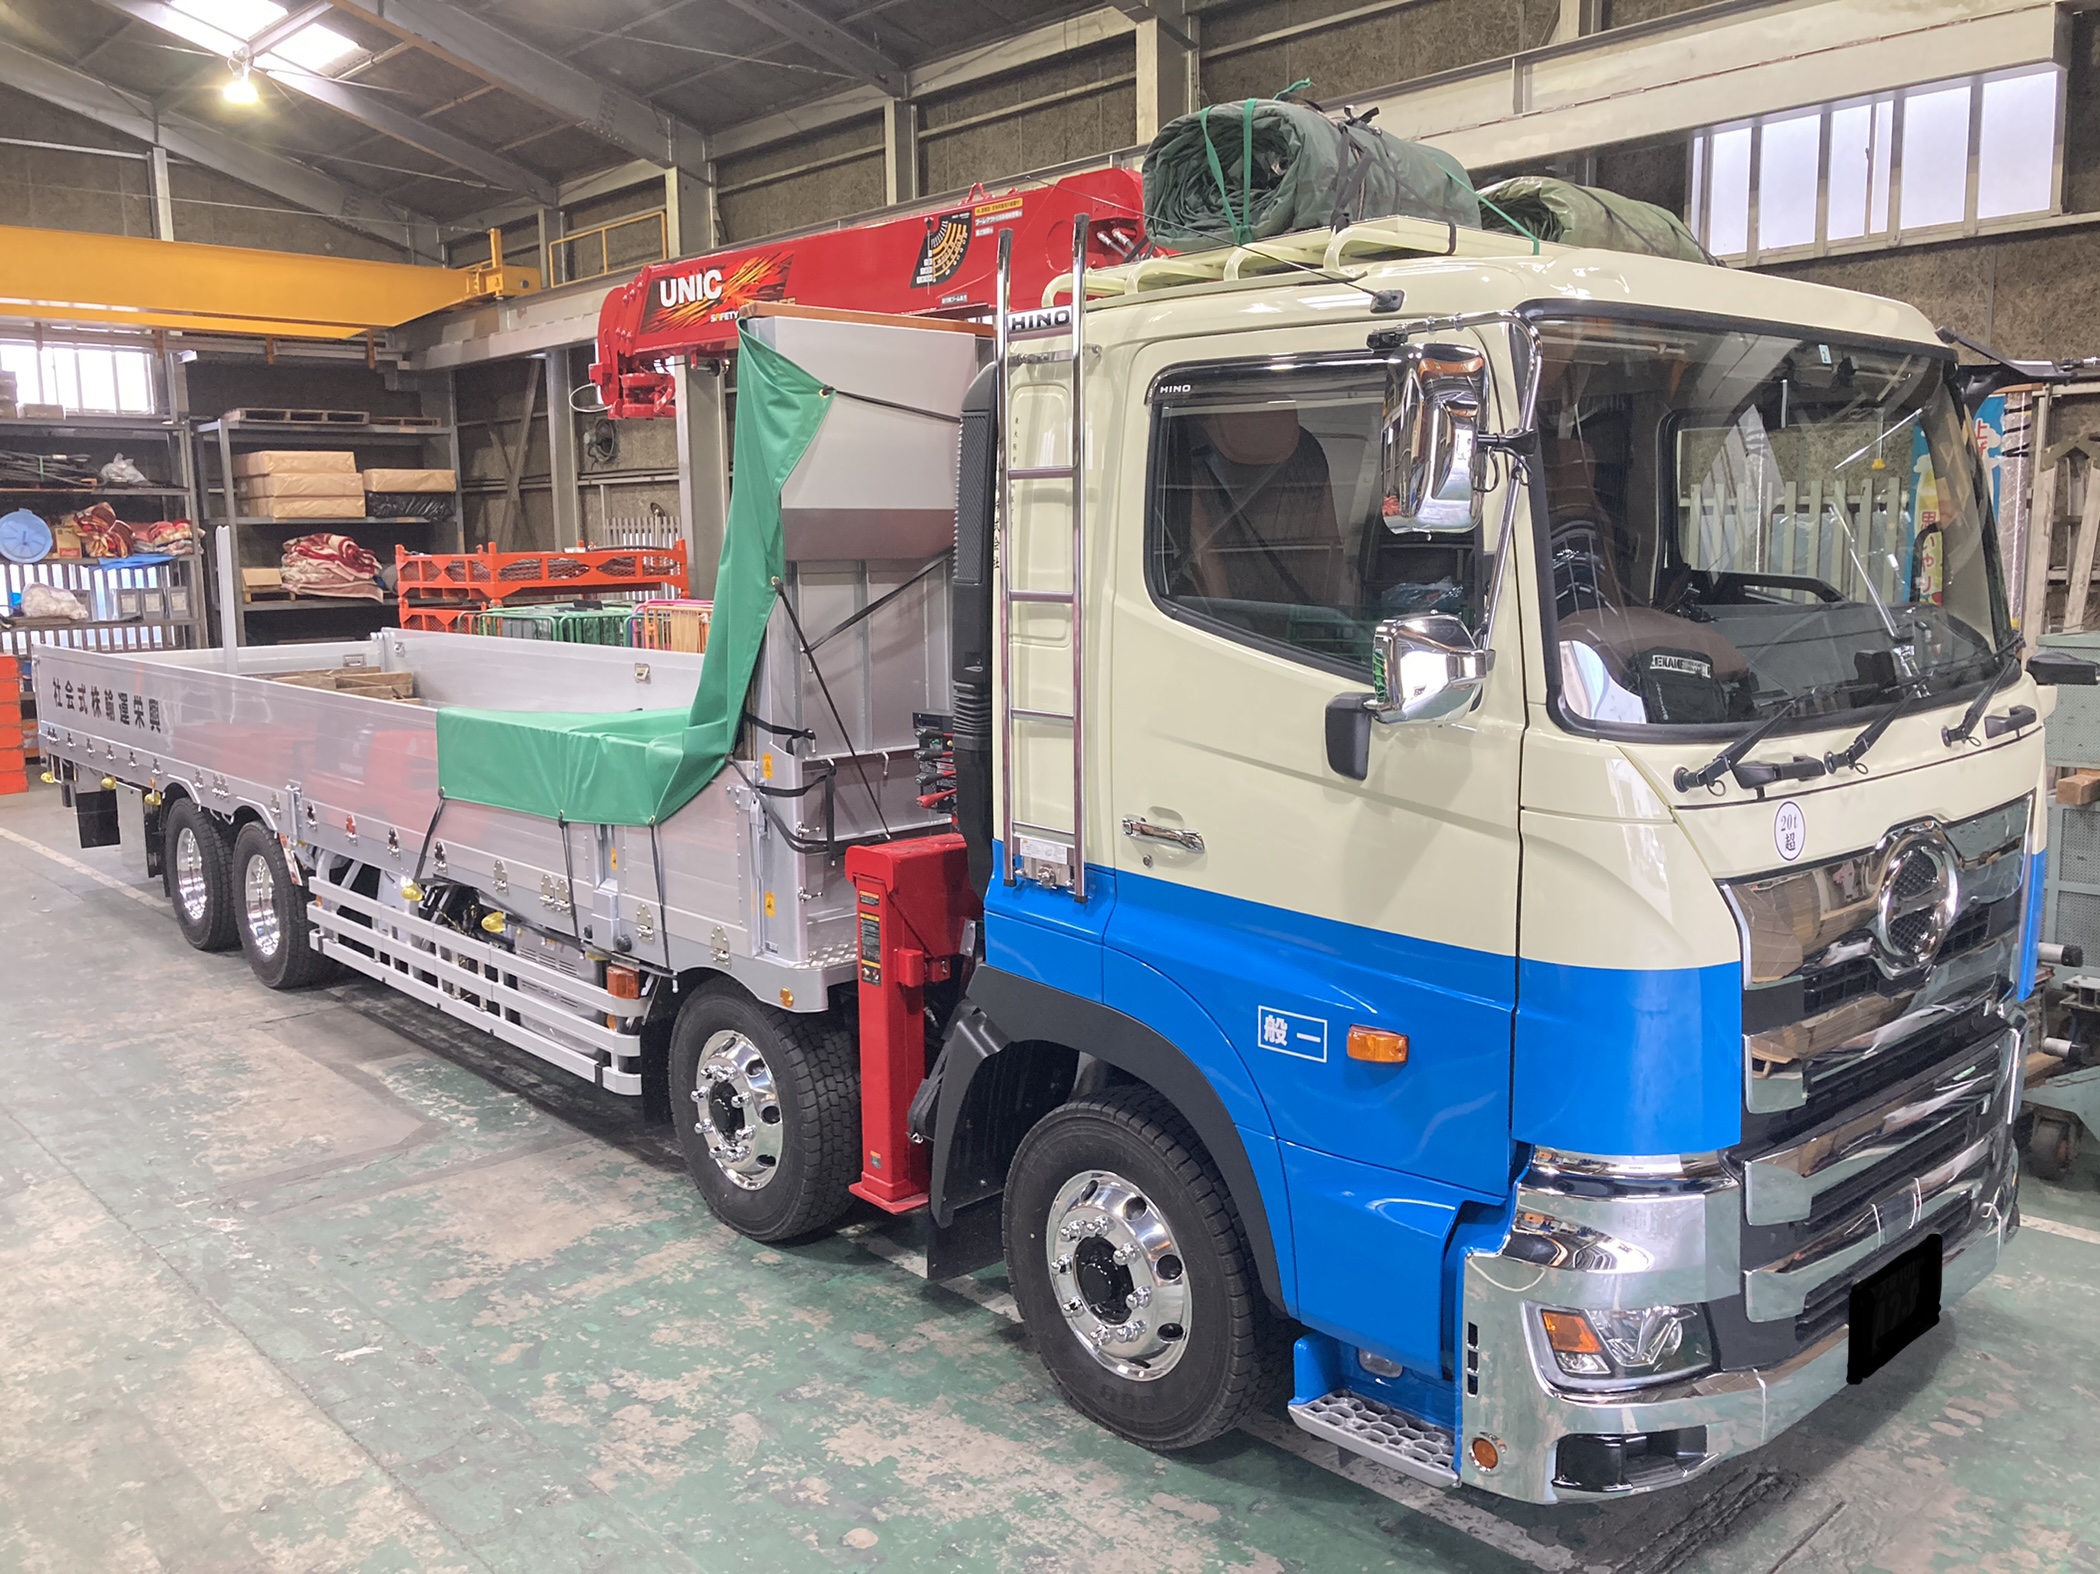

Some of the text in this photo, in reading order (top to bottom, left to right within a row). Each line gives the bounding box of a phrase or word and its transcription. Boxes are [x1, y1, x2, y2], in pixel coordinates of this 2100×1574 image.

[660, 269, 723, 307] UNIC
[1011, 309, 1070, 331] HINO
[1160, 384, 1192, 394] HINO
